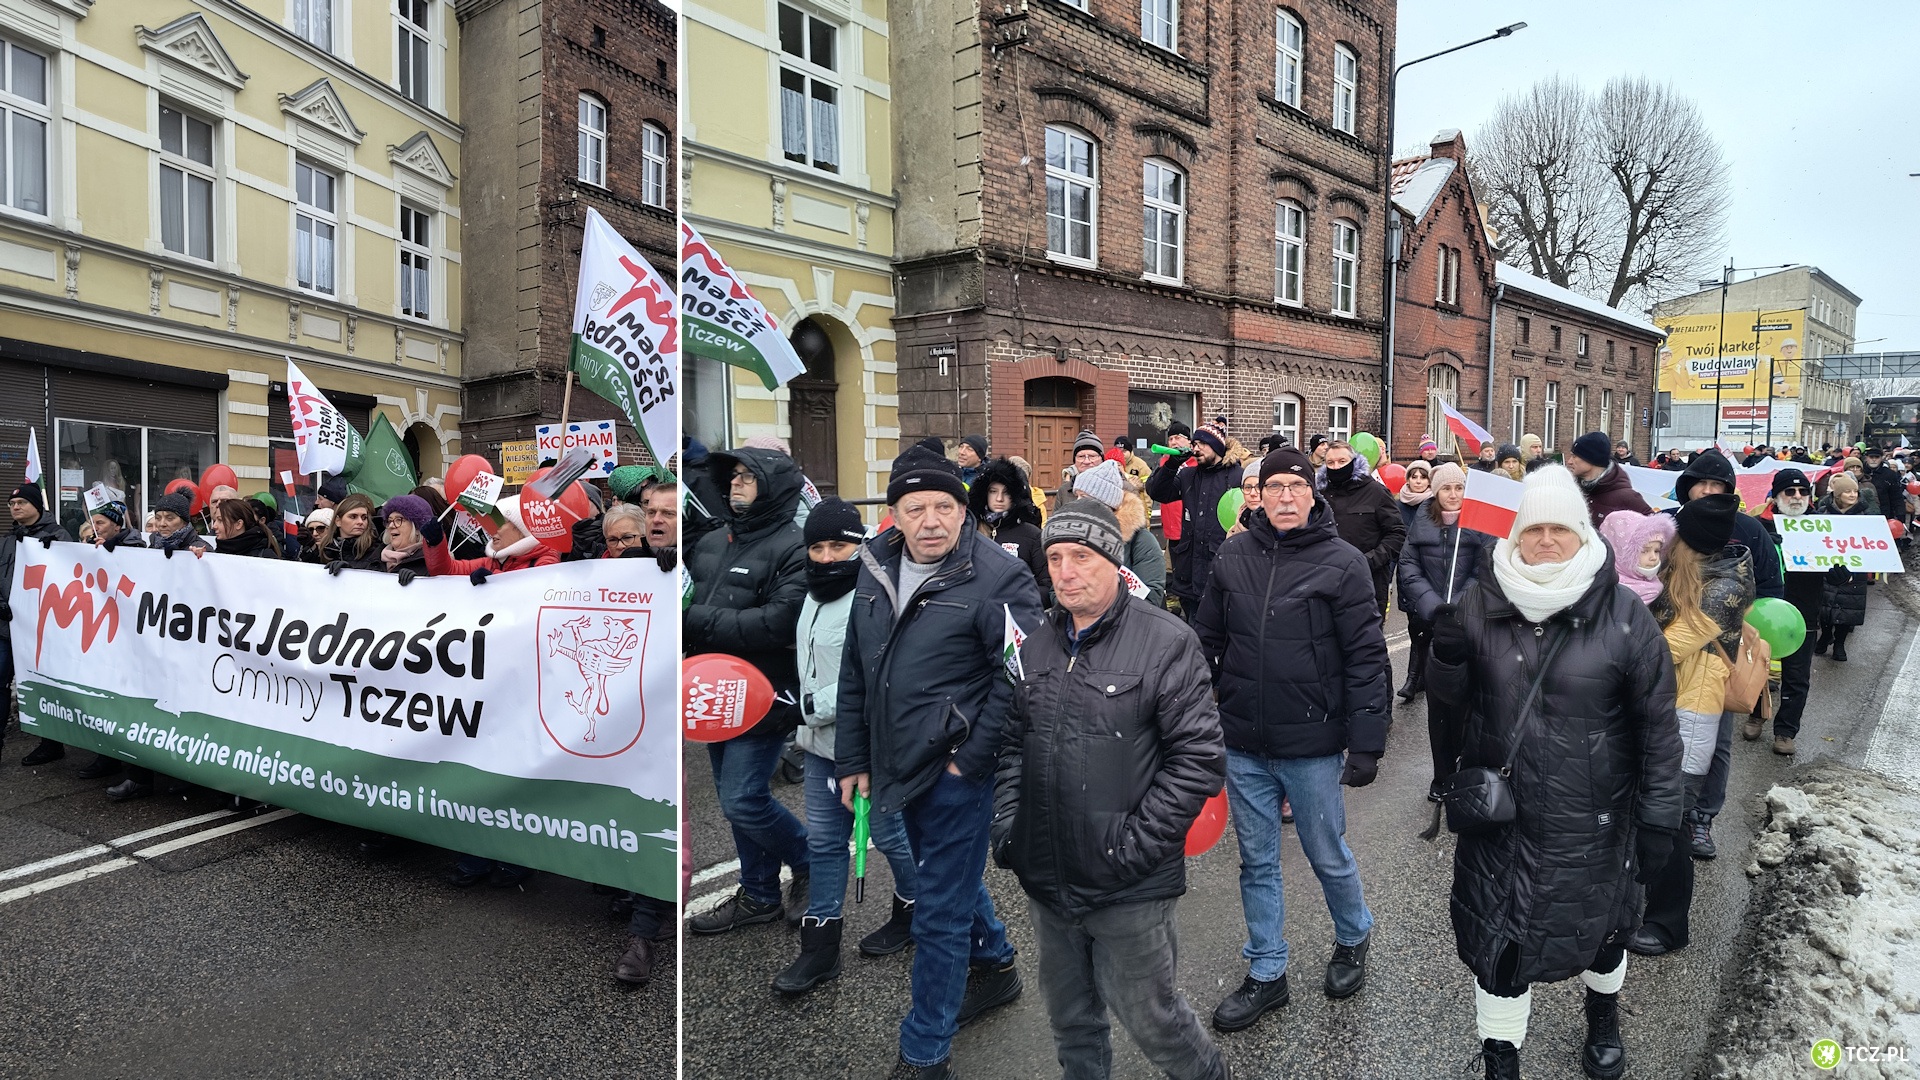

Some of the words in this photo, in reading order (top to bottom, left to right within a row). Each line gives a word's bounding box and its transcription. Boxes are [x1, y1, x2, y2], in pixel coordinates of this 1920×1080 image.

[682, 267, 767, 333] Marsz
[682, 293, 757, 340] ności
[688, 323, 747, 352] Tczew
[1675, 325, 1713, 333] METALZBYT
[616, 311, 675, 403] Marsz
[1686, 343, 1715, 356] Twój
[1719, 341, 1760, 353] Market
[941, 359, 945, 375] 1
[1692, 358, 1758, 371] Budowlany
[603, 363, 637, 428] Tczew
[505, 444, 523, 452] KOŁO
[539, 432, 613, 450] KOCHAM
[472, 485, 489, 495] Marsz
[535, 515, 562, 526] Marsz
[1783, 518, 1832, 533] KGW
[1822, 536, 1889, 554] tylko
[1792, 555, 1809, 566] u
[1815, 555, 1863, 567] nas
[543, 587, 591, 602] Gmina
[598, 588, 653, 604] Tczew
[136, 591, 256, 652] Marsz
[256, 607, 494, 680] Jedności
[212, 653, 323, 722] Gminy
[329, 673, 484, 738] Tczew
[712, 679, 727, 715] Marsz
[721, 679, 737, 729] Jedności
[38, 696, 74, 723] Gmina
[74, 708, 117, 736] Tczew
[126, 722, 228, 766] atrakcyjne
[232, 745, 316, 789] miejsce
[319, 770, 348, 796] do
[352, 774, 412, 807] życia
[416, 786, 425, 813] i
[429, 788, 639, 853] inwestowania
